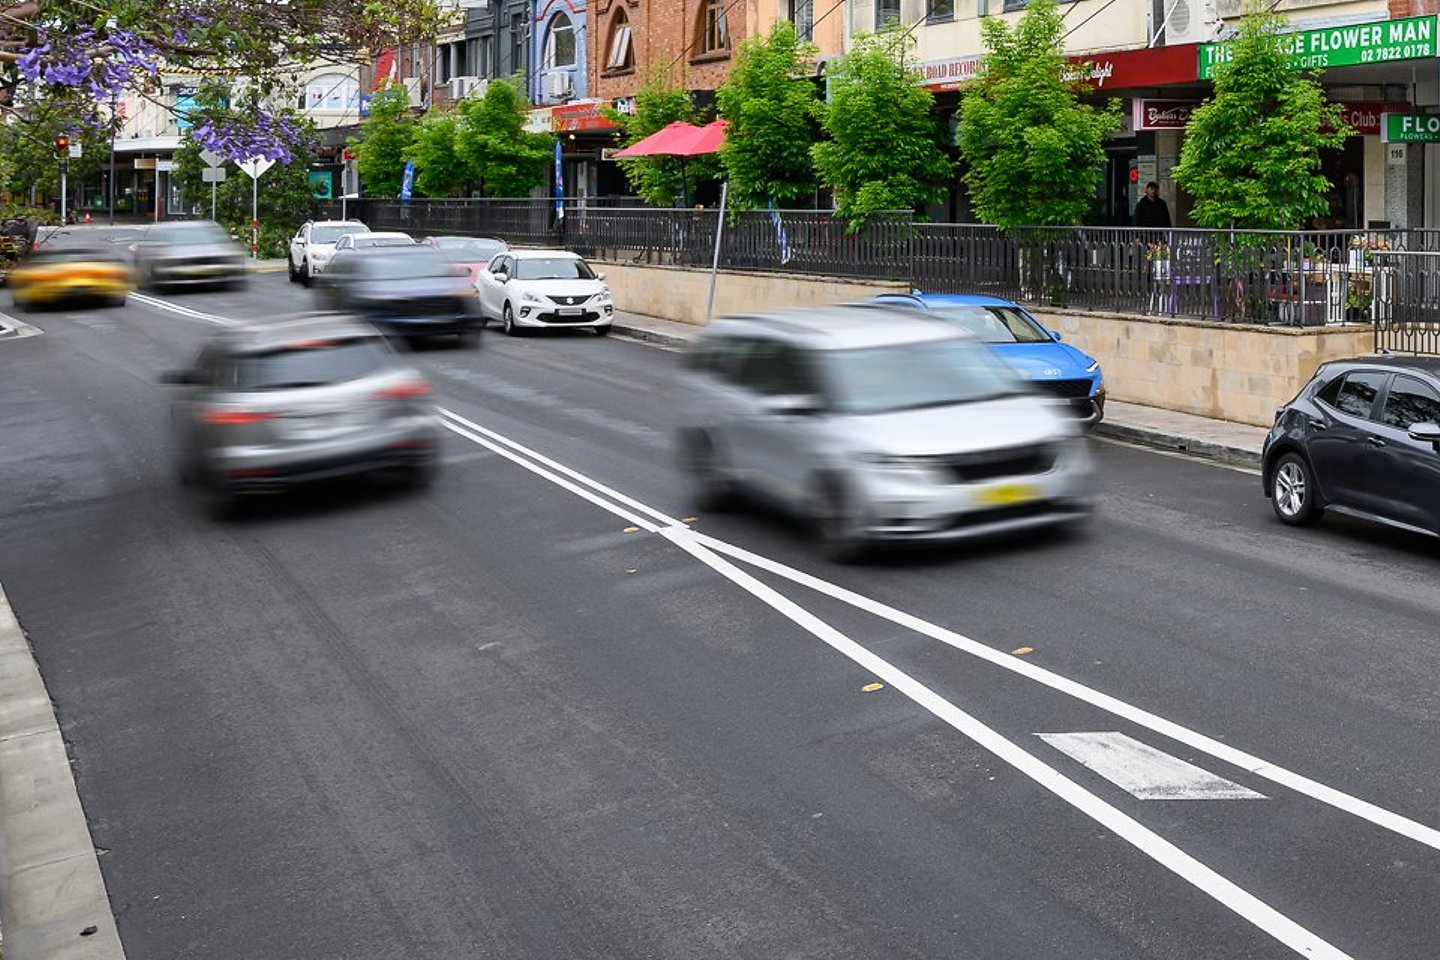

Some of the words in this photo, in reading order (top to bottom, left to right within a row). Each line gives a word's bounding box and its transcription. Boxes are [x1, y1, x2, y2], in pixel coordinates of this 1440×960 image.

[1311, 26, 1383, 52] FLOWER
[1389, 20, 1431, 42] MAN
[1301, 54, 1328, 68] GIFTS
[1361, 49, 1373, 62] 02
[1376, 46, 1401, 61] 7822
[1404, 43, 1430, 57] 0178
[1351, 111, 1376, 127] Club
